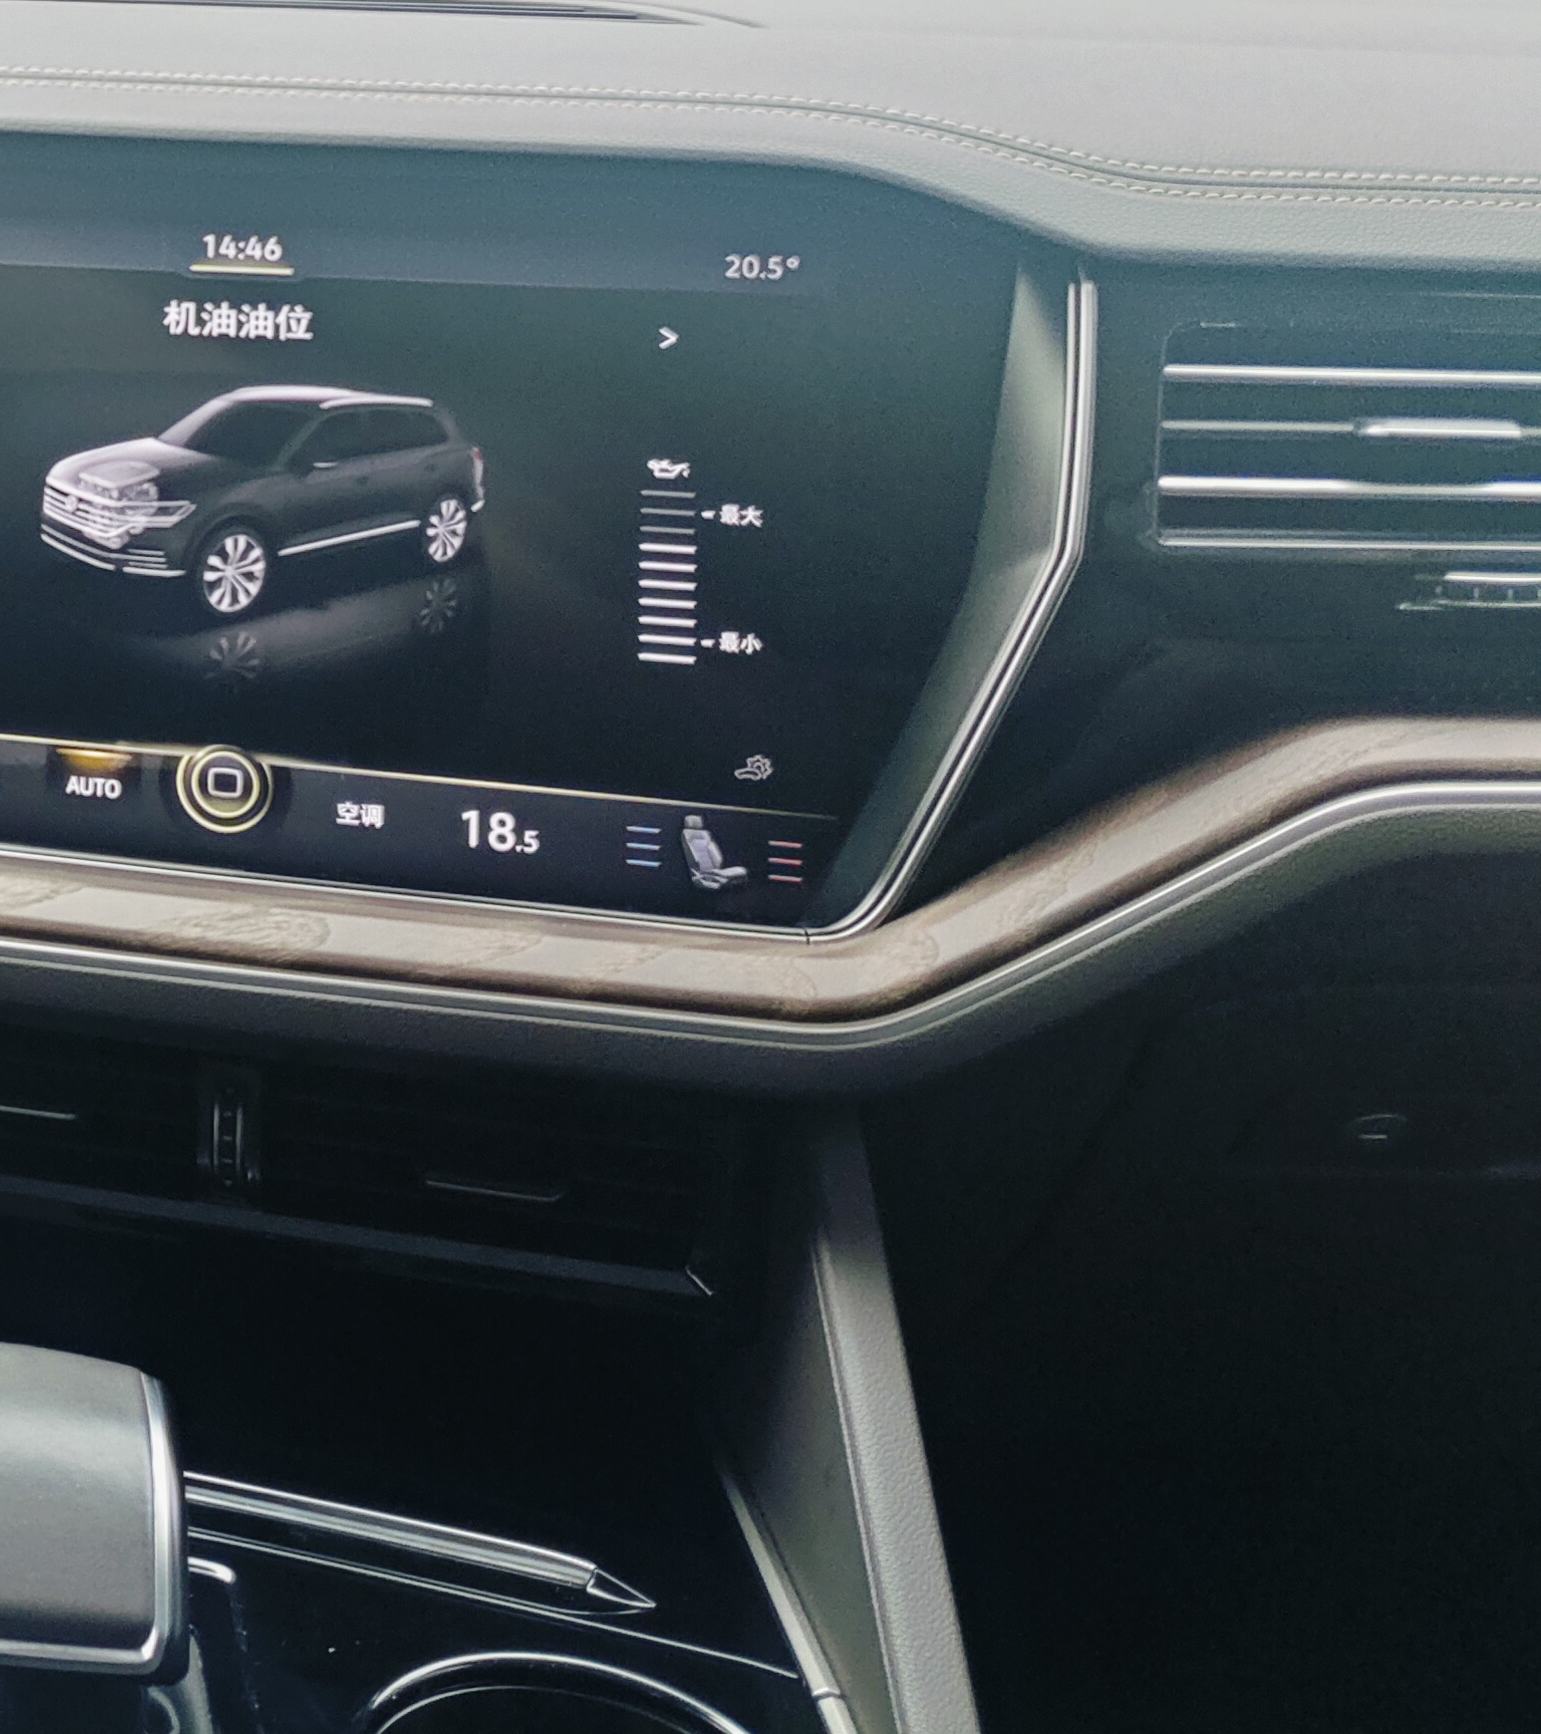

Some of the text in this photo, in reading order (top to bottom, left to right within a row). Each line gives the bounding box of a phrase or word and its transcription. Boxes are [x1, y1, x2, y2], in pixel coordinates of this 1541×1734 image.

[202, 233, 283, 262] 14:46
[162, 299, 314, 341] 机油油位
[719, 503, 764, 527] 最大
[719, 630, 764, 655] 最小
[65, 774, 123, 800] AUTO
[335, 800, 386, 830] 空调
